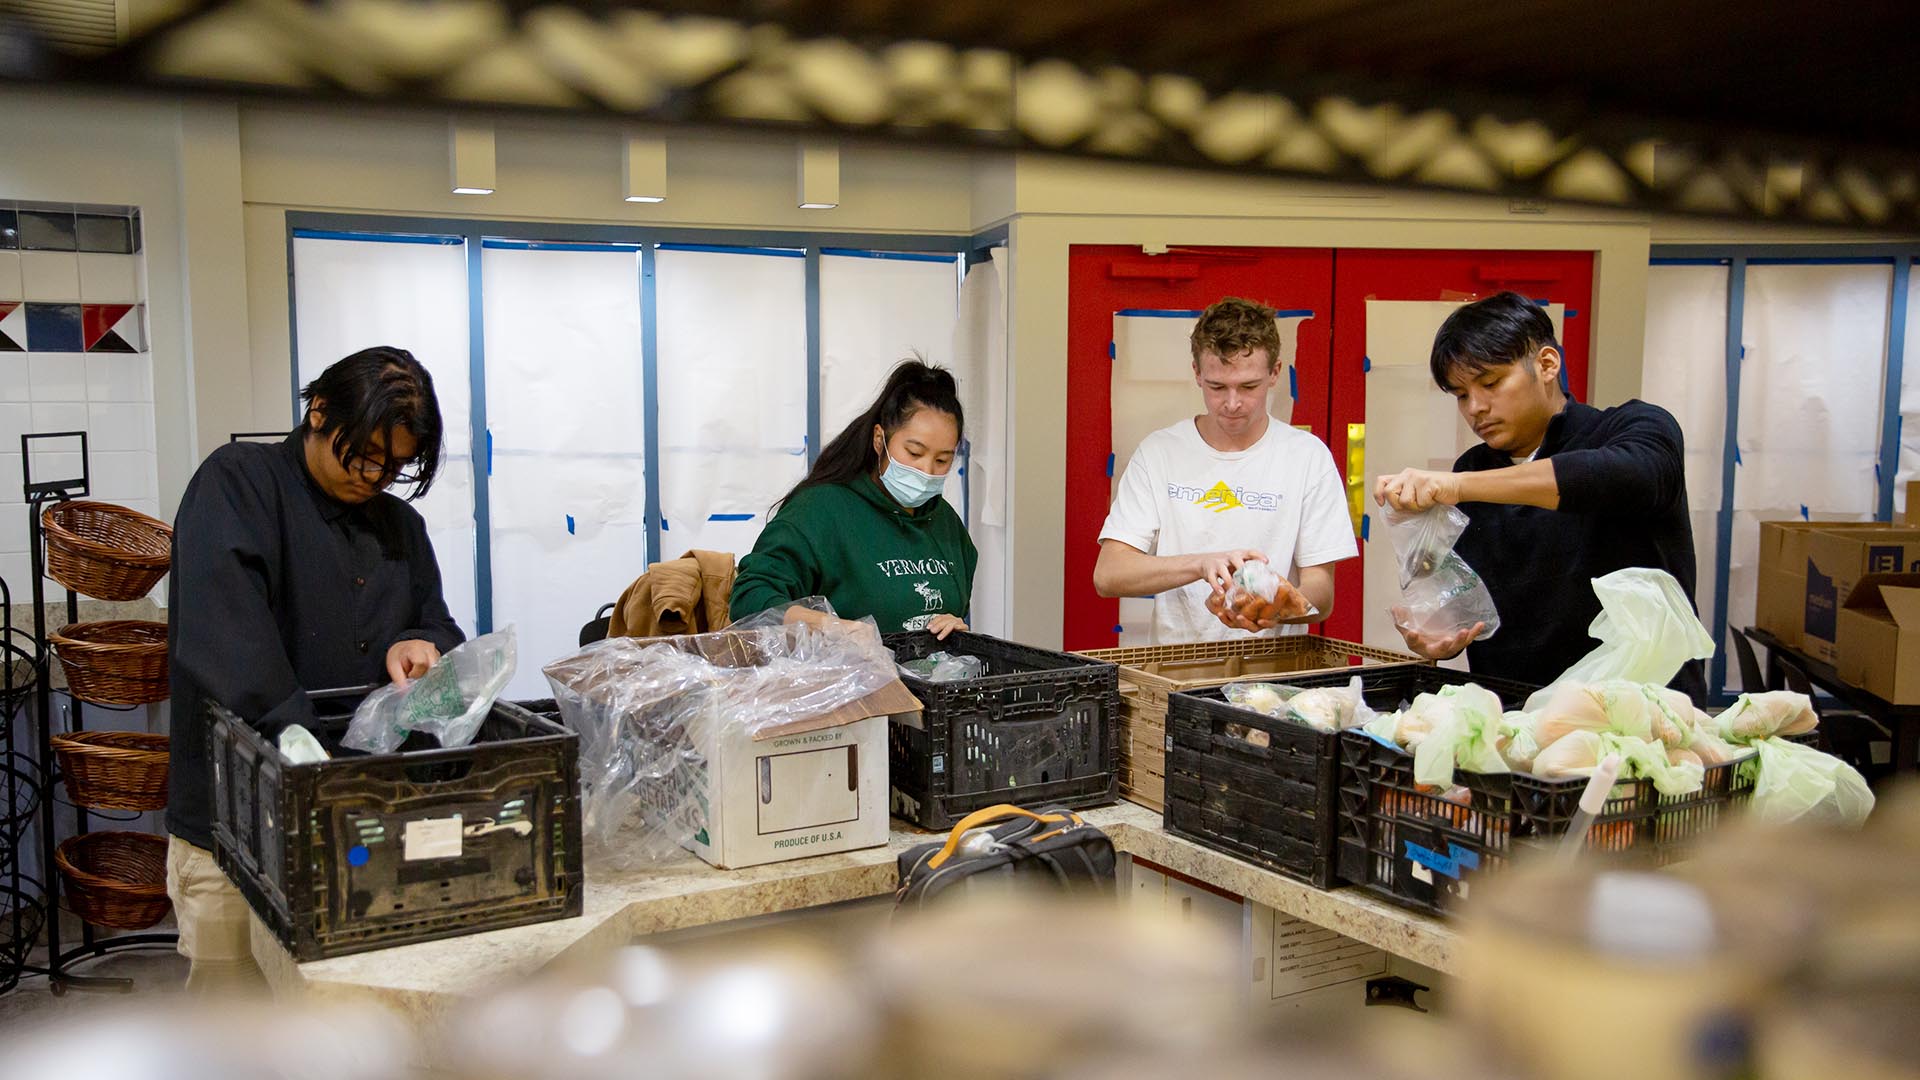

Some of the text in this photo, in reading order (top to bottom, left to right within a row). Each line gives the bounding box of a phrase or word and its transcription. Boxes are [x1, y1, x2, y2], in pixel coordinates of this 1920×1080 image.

[774, 738, 801, 748] GROWN
[809, 734, 834, 744] PACKED
[774, 836, 809, 849] PRODUCE
[810, 834, 820, 844] OF
